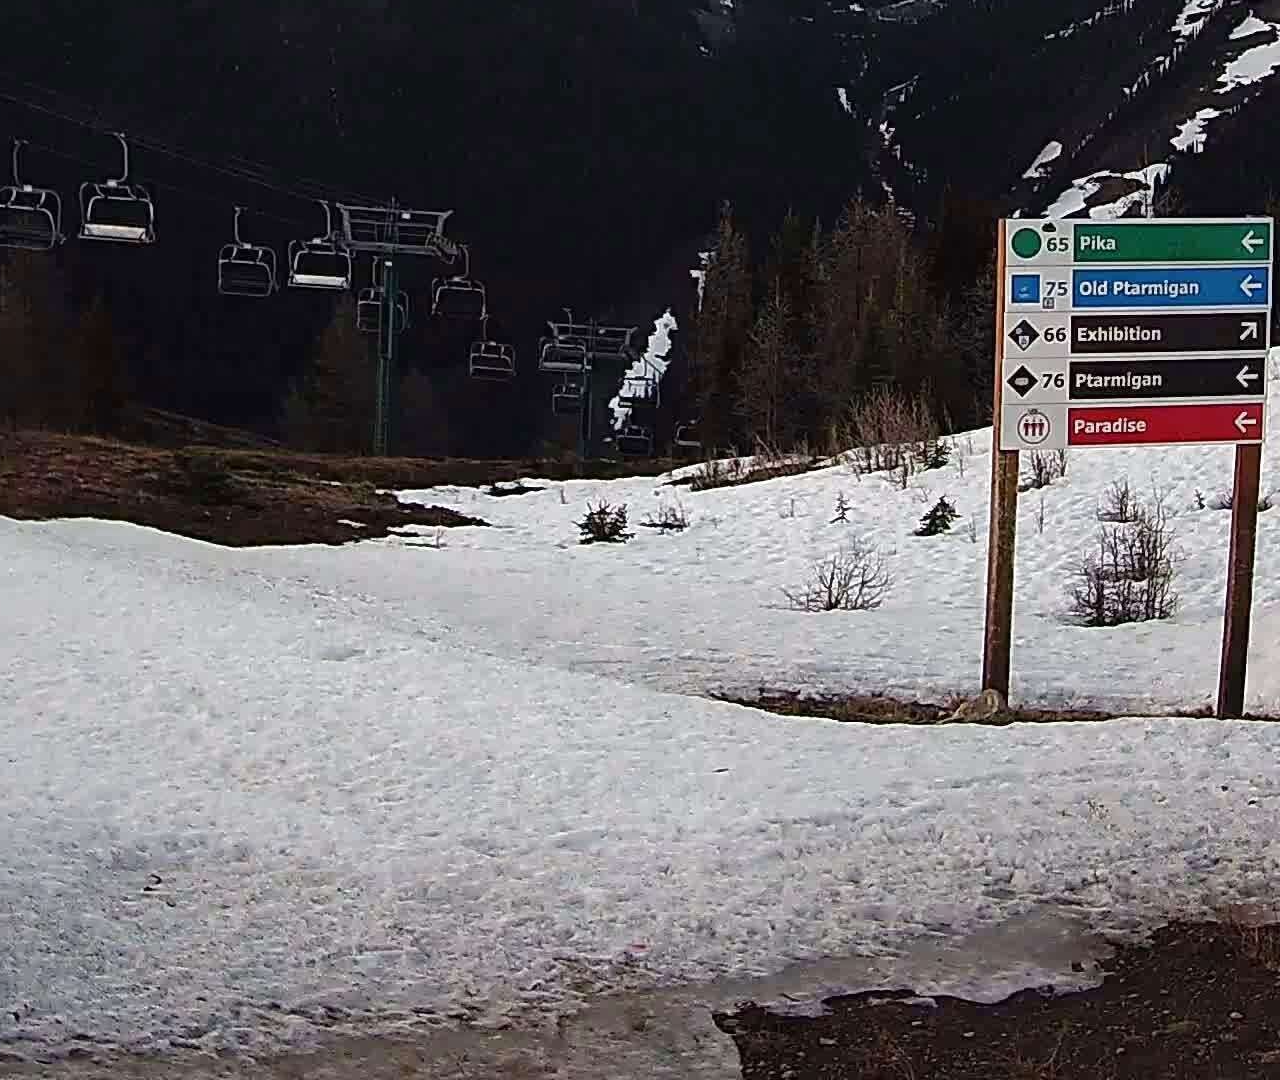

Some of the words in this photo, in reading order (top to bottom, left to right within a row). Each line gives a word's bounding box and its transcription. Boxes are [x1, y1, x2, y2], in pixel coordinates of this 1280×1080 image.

[1046, 238, 1069, 252] 65
[1080, 235, 1116, 251] Pika
[1046, 281, 1068, 296] 75
[1079, 280, 1107, 296] Old
[1114, 279, 1199, 299] Ptarmigan
[1044, 327, 1066, 342] 66
[1077, 326, 1161, 342] Exhibition
[1042, 373, 1065, 388] 76
[1076, 372, 1162, 391] Ptarmigan
[1074, 418, 1146, 434] Paradise
